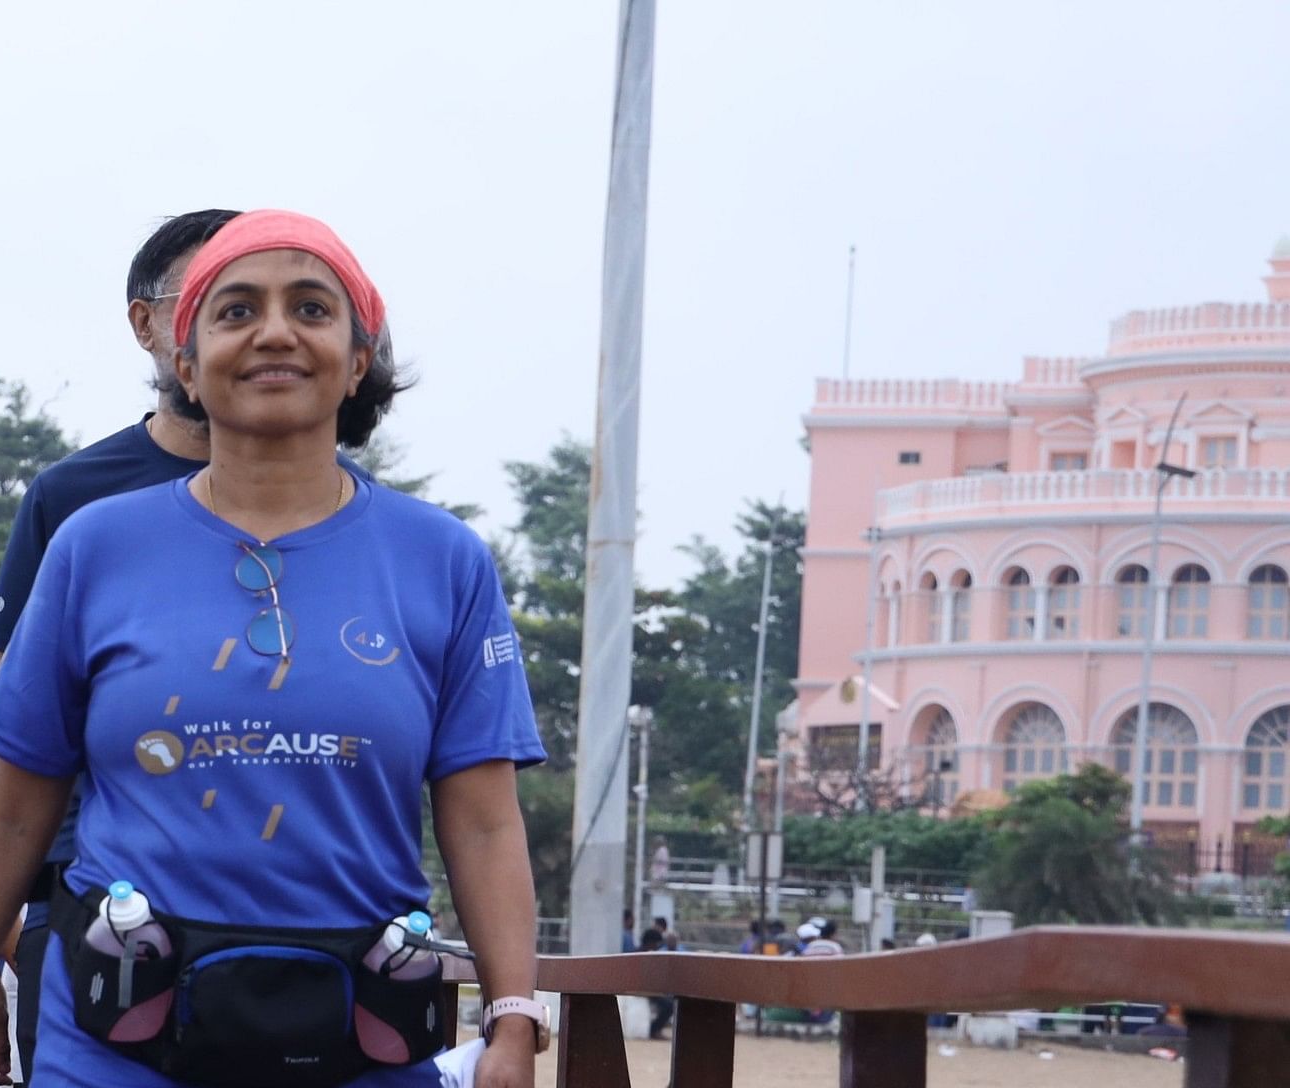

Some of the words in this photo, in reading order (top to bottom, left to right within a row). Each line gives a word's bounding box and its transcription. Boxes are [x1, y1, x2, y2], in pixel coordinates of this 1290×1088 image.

[184, 720, 231, 735] Walk
[242, 718, 272, 730] for
[188, 732, 359, 759] ARCAUSE
[187, 760, 214, 768] our
[232, 757, 357, 768] responsibility
